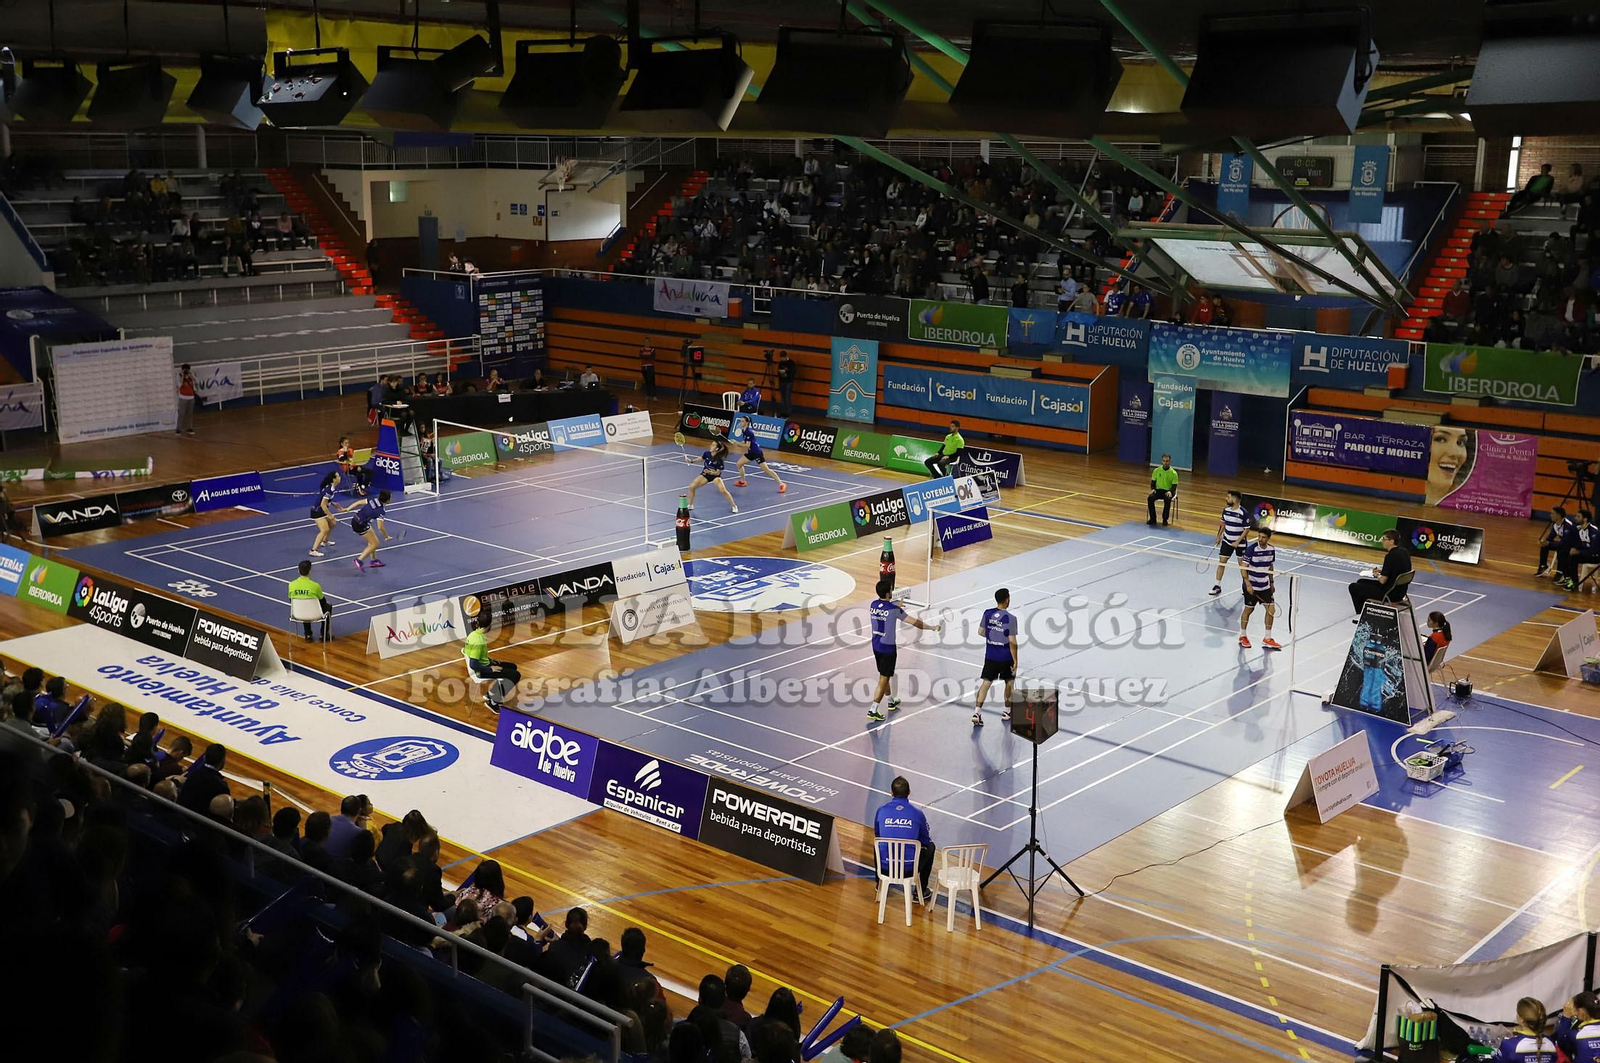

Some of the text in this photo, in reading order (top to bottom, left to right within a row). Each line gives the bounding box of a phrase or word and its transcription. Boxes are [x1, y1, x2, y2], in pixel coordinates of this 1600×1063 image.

[658, 280, 722, 306] Andalucía
[857, 311, 873, 319] Puerto
[882, 314, 900, 322] Huelva
[924, 327, 996, 346] IBERDROLA
[1088, 325, 1143, 343] DIPUTACIÓN
[1088, 335, 1137, 349] DE HUELVA
[1201, 348, 1246, 357] Ayuntamiento
[1223, 356, 1245, 364] Huelva
[1331, 346, 1400, 362] DIPUTACIÓN
[1330, 359, 1344, 370] DE
[1157, 381, 1193, 392] Fundación
[1449, 376, 1559, 401] IBERDROLA
[888, 380, 1083, 414] Fundación Cajasol Fundación Cajasol
[1158, 395, 1192, 411] Cajasol
[567, 421, 600, 433] LOTERÍAS
[800, 428, 835, 444] LaLiga
[515, 430, 549, 444] LaLiga
[1344, 432, 1365, 441] BAR
[1376, 435, 1425, 448] TERRAZA
[519, 441, 551, 455] 4Sports
[799, 441, 831, 453] 4Sports
[843, 449, 881, 462] IBERDROLA
[1295, 448, 1335, 457] HUELVA
[1344, 442, 1423, 459] PARQUE MORET
[1509, 446, 1535, 457] Dental
[451, 452, 490, 465] IBERDROLA
[210, 488, 230, 498] AGUAS
[240, 484, 261, 493] HUELVA
[922, 485, 955, 500] LOTERÍAS
[44, 504, 117, 523] VANDA
[871, 497, 905, 516] LaLiga
[875, 510, 907, 528] 4Sports
[808, 527, 848, 545] IBERDROLA
[952, 525, 967, 535] AGUAS
[967, 523, 973, 531] DE
[1437, 532, 1467, 546] LaLiga
[616, 559, 682, 583] Fundación Cajasol
[481, 583, 535, 604] enclave
[545, 574, 614, 598] VANDA
[28, 586, 63, 606] IBERDROLA
[93, 587, 129, 613] LaLiga
[89, 606, 123, 627] 4Sports
[870, 608, 889, 617] ZAPICO
[146, 617, 161, 629] Puerto
[162, 622, 168, 630] de
[169, 623, 185, 636] Huelva
[197, 618, 259, 650] POWERADE
[386, 612, 457, 646] Andalucía
[194, 633, 253, 663] bebida para deportistas
[136, 655, 280, 711] de Huelva
[97, 664, 302, 747] Ayuntamiento
[1025, 708, 1035, 730] 4
[511, 720, 581, 770] aiqbe
[542, 759, 576, 783] de Huelva
[684, 753, 826, 804] POWERADE
[705, 749, 840, 797] bebida para deportistas
[1315, 756, 1357, 786] TOYOTA HUELVA
[606, 779, 685, 819] Espanicar
[605, 800, 623, 811] Alquiler
[671, 823, 680, 831] Car
[712, 788, 822, 840] POWERADE
[884, 818, 913, 826] GLACIA
[710, 809, 817, 856] bebida para deportistas
